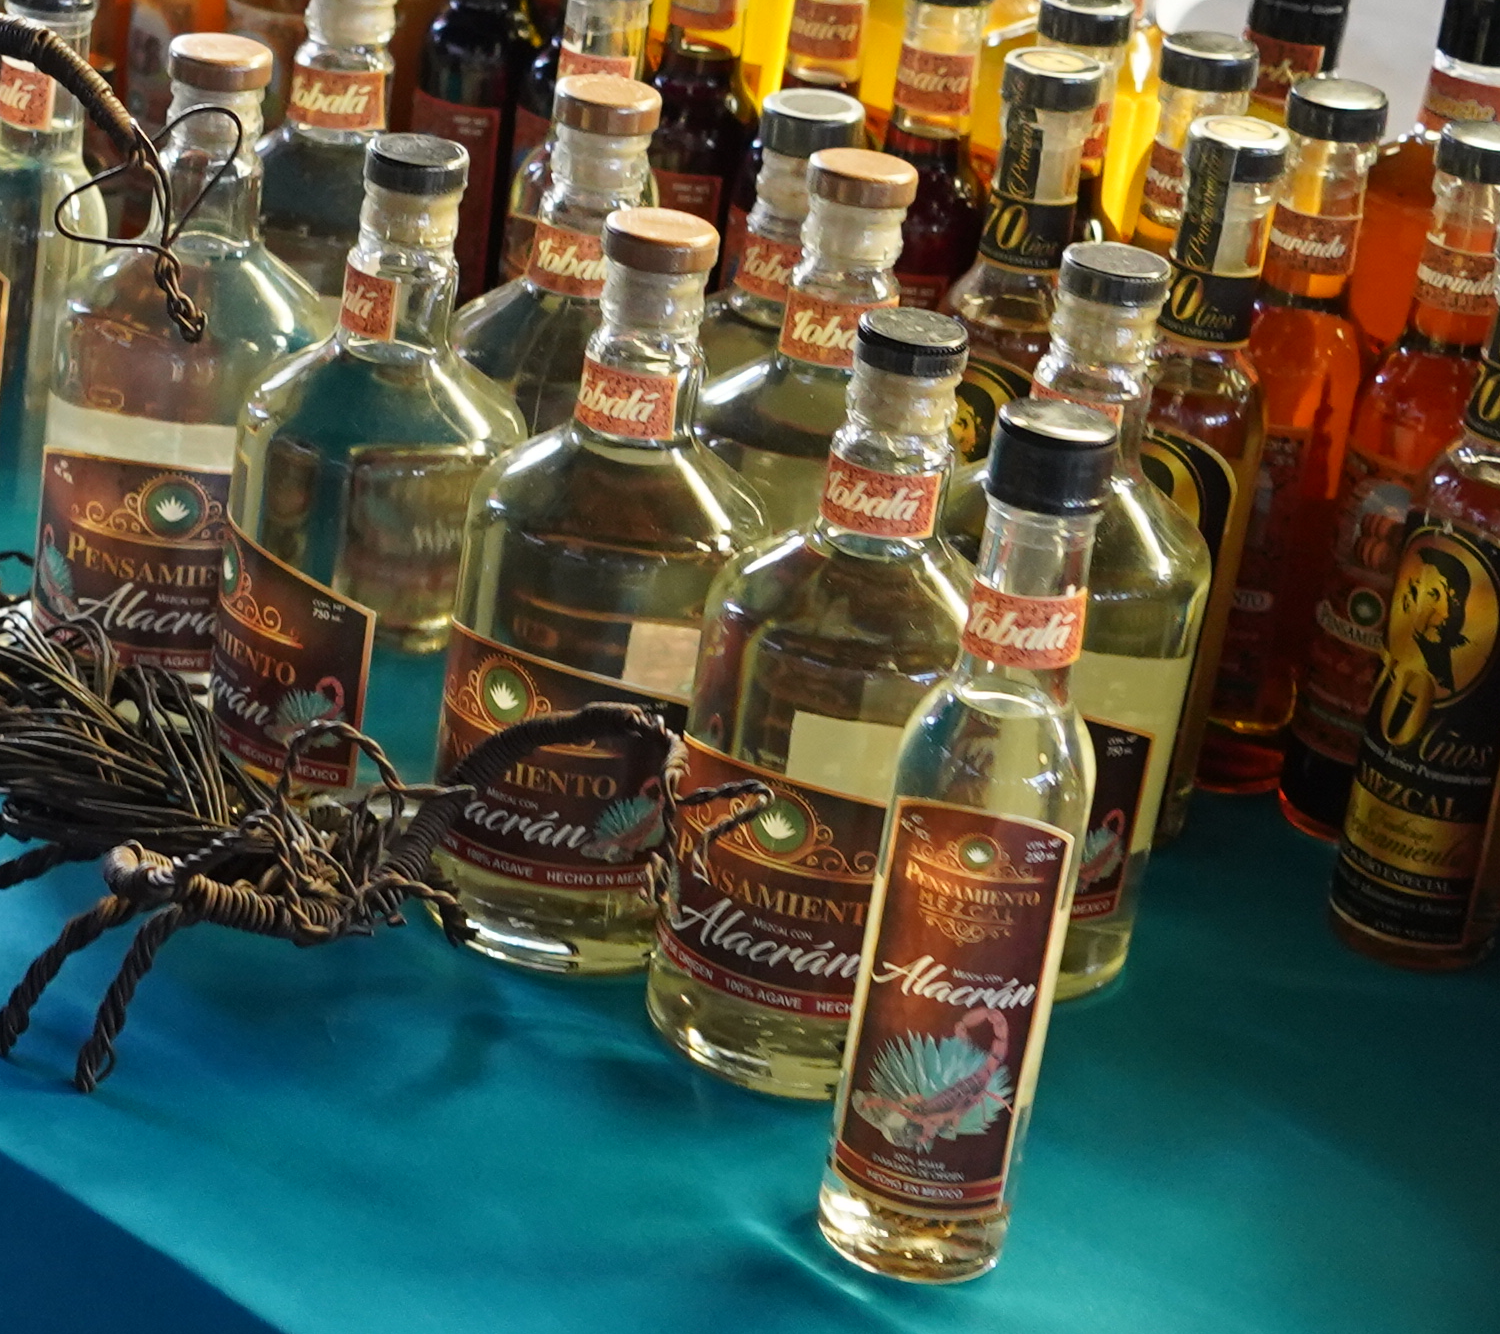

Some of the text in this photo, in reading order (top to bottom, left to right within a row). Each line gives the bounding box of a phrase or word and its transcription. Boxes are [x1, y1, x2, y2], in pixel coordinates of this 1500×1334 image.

[793, 309, 858, 350] Toba
[827, 469, 925, 522] Tobalá
[66, 530, 216, 587] PENSAMIE
[968, 600, 1077, 651] Tobalá
[463, 800, 592, 849] acrán
[546, 871, 594, 886] HECHO
[596, 874, 614, 885] EN
[617, 872, 648, 885] MEXI
[904, 858, 1042, 908] PENSAMIENTO
[918, 886, 1016, 926] MEZCAL
[756, 988, 802, 1011] AGAVE
[815, 999, 853, 1014] HECH
[871, 953, 1037, 1009] Alacrán
